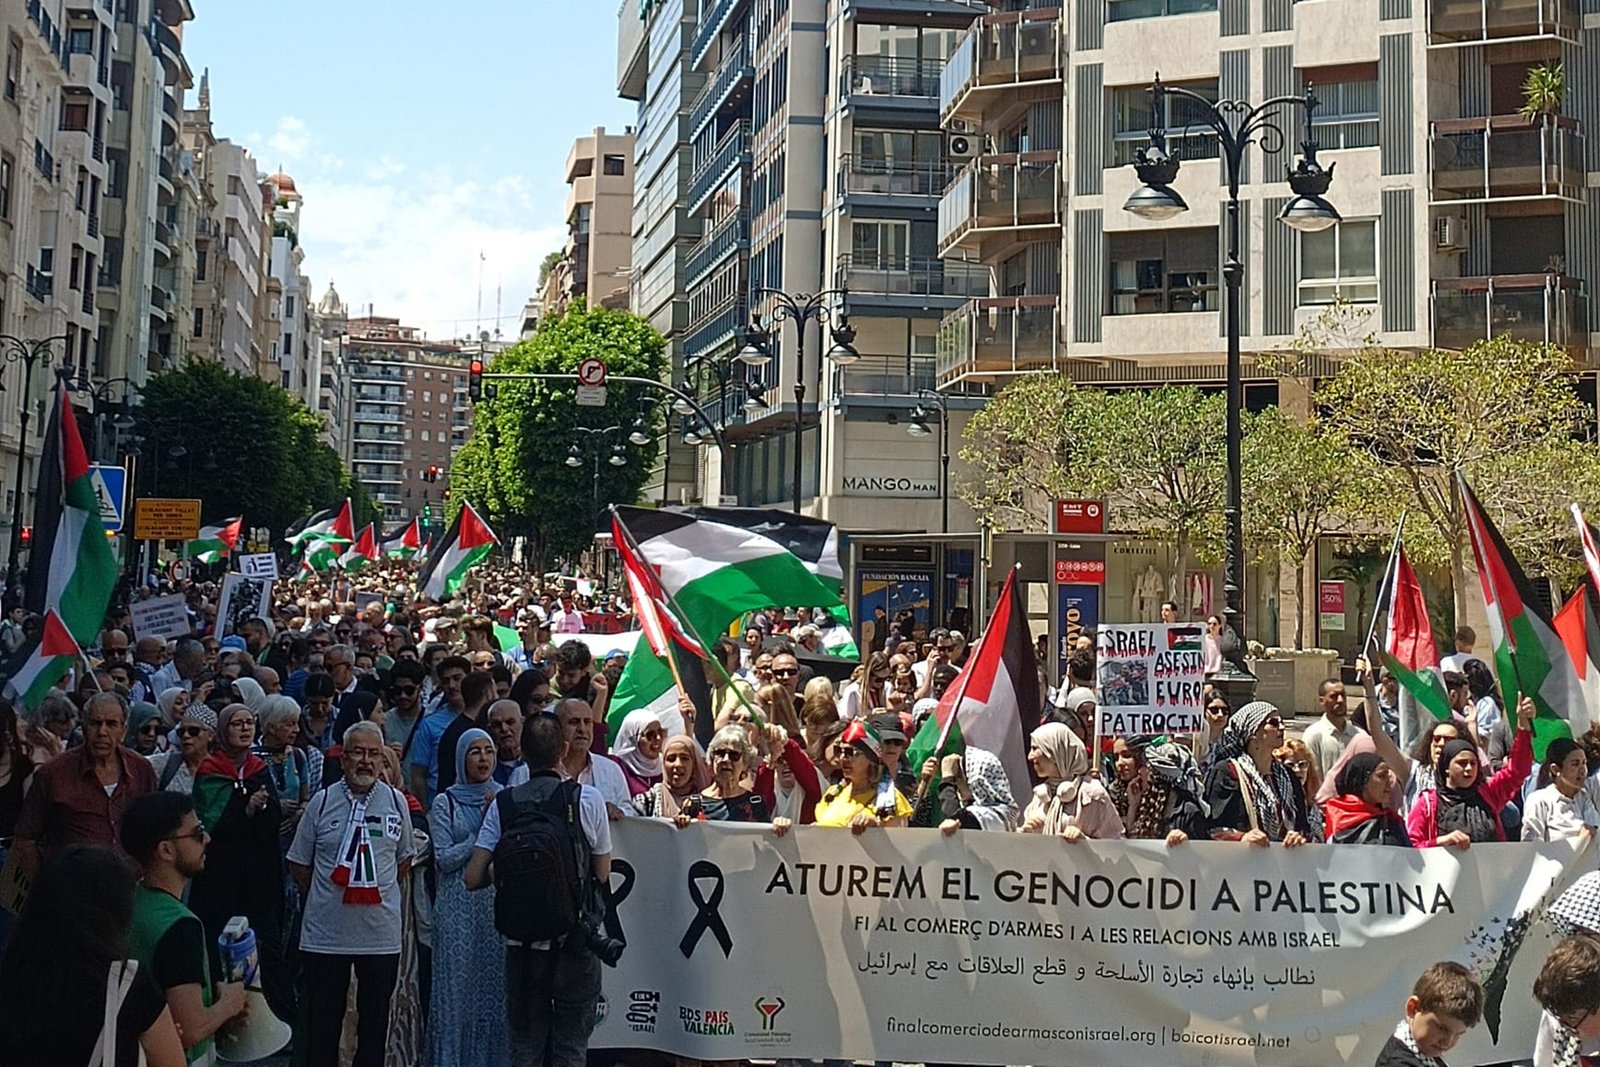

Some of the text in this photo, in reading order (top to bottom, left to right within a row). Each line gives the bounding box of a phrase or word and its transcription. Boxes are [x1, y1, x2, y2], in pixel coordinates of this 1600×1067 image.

[842, 477, 911, 490] MANGO
[1156, 680, 1204, 705] EURO
[1102, 712, 1205, 733] PATROCIN
[765, 862, 1455, 915] ATUREM EL GENOCIDI A PALESTINA
[854, 916, 1341, 948] FI AL COMERÇ D'ARMES I A LES RELACIONS AMB ISRAEL
[857, 951, 1316, 991] نطالب بإنهاء تجارة الأسلحة و قطع العلاقات مع إسرائيل
[679, 1006, 729, 1024] BDS PAÍS
[684, 1020, 735, 1036] VALENCIÀ
[887, 1016, 1156, 1046] finalcomerciodearmasconisrael.org
[1171, 1028, 1290, 1049] boicotisrael.net
